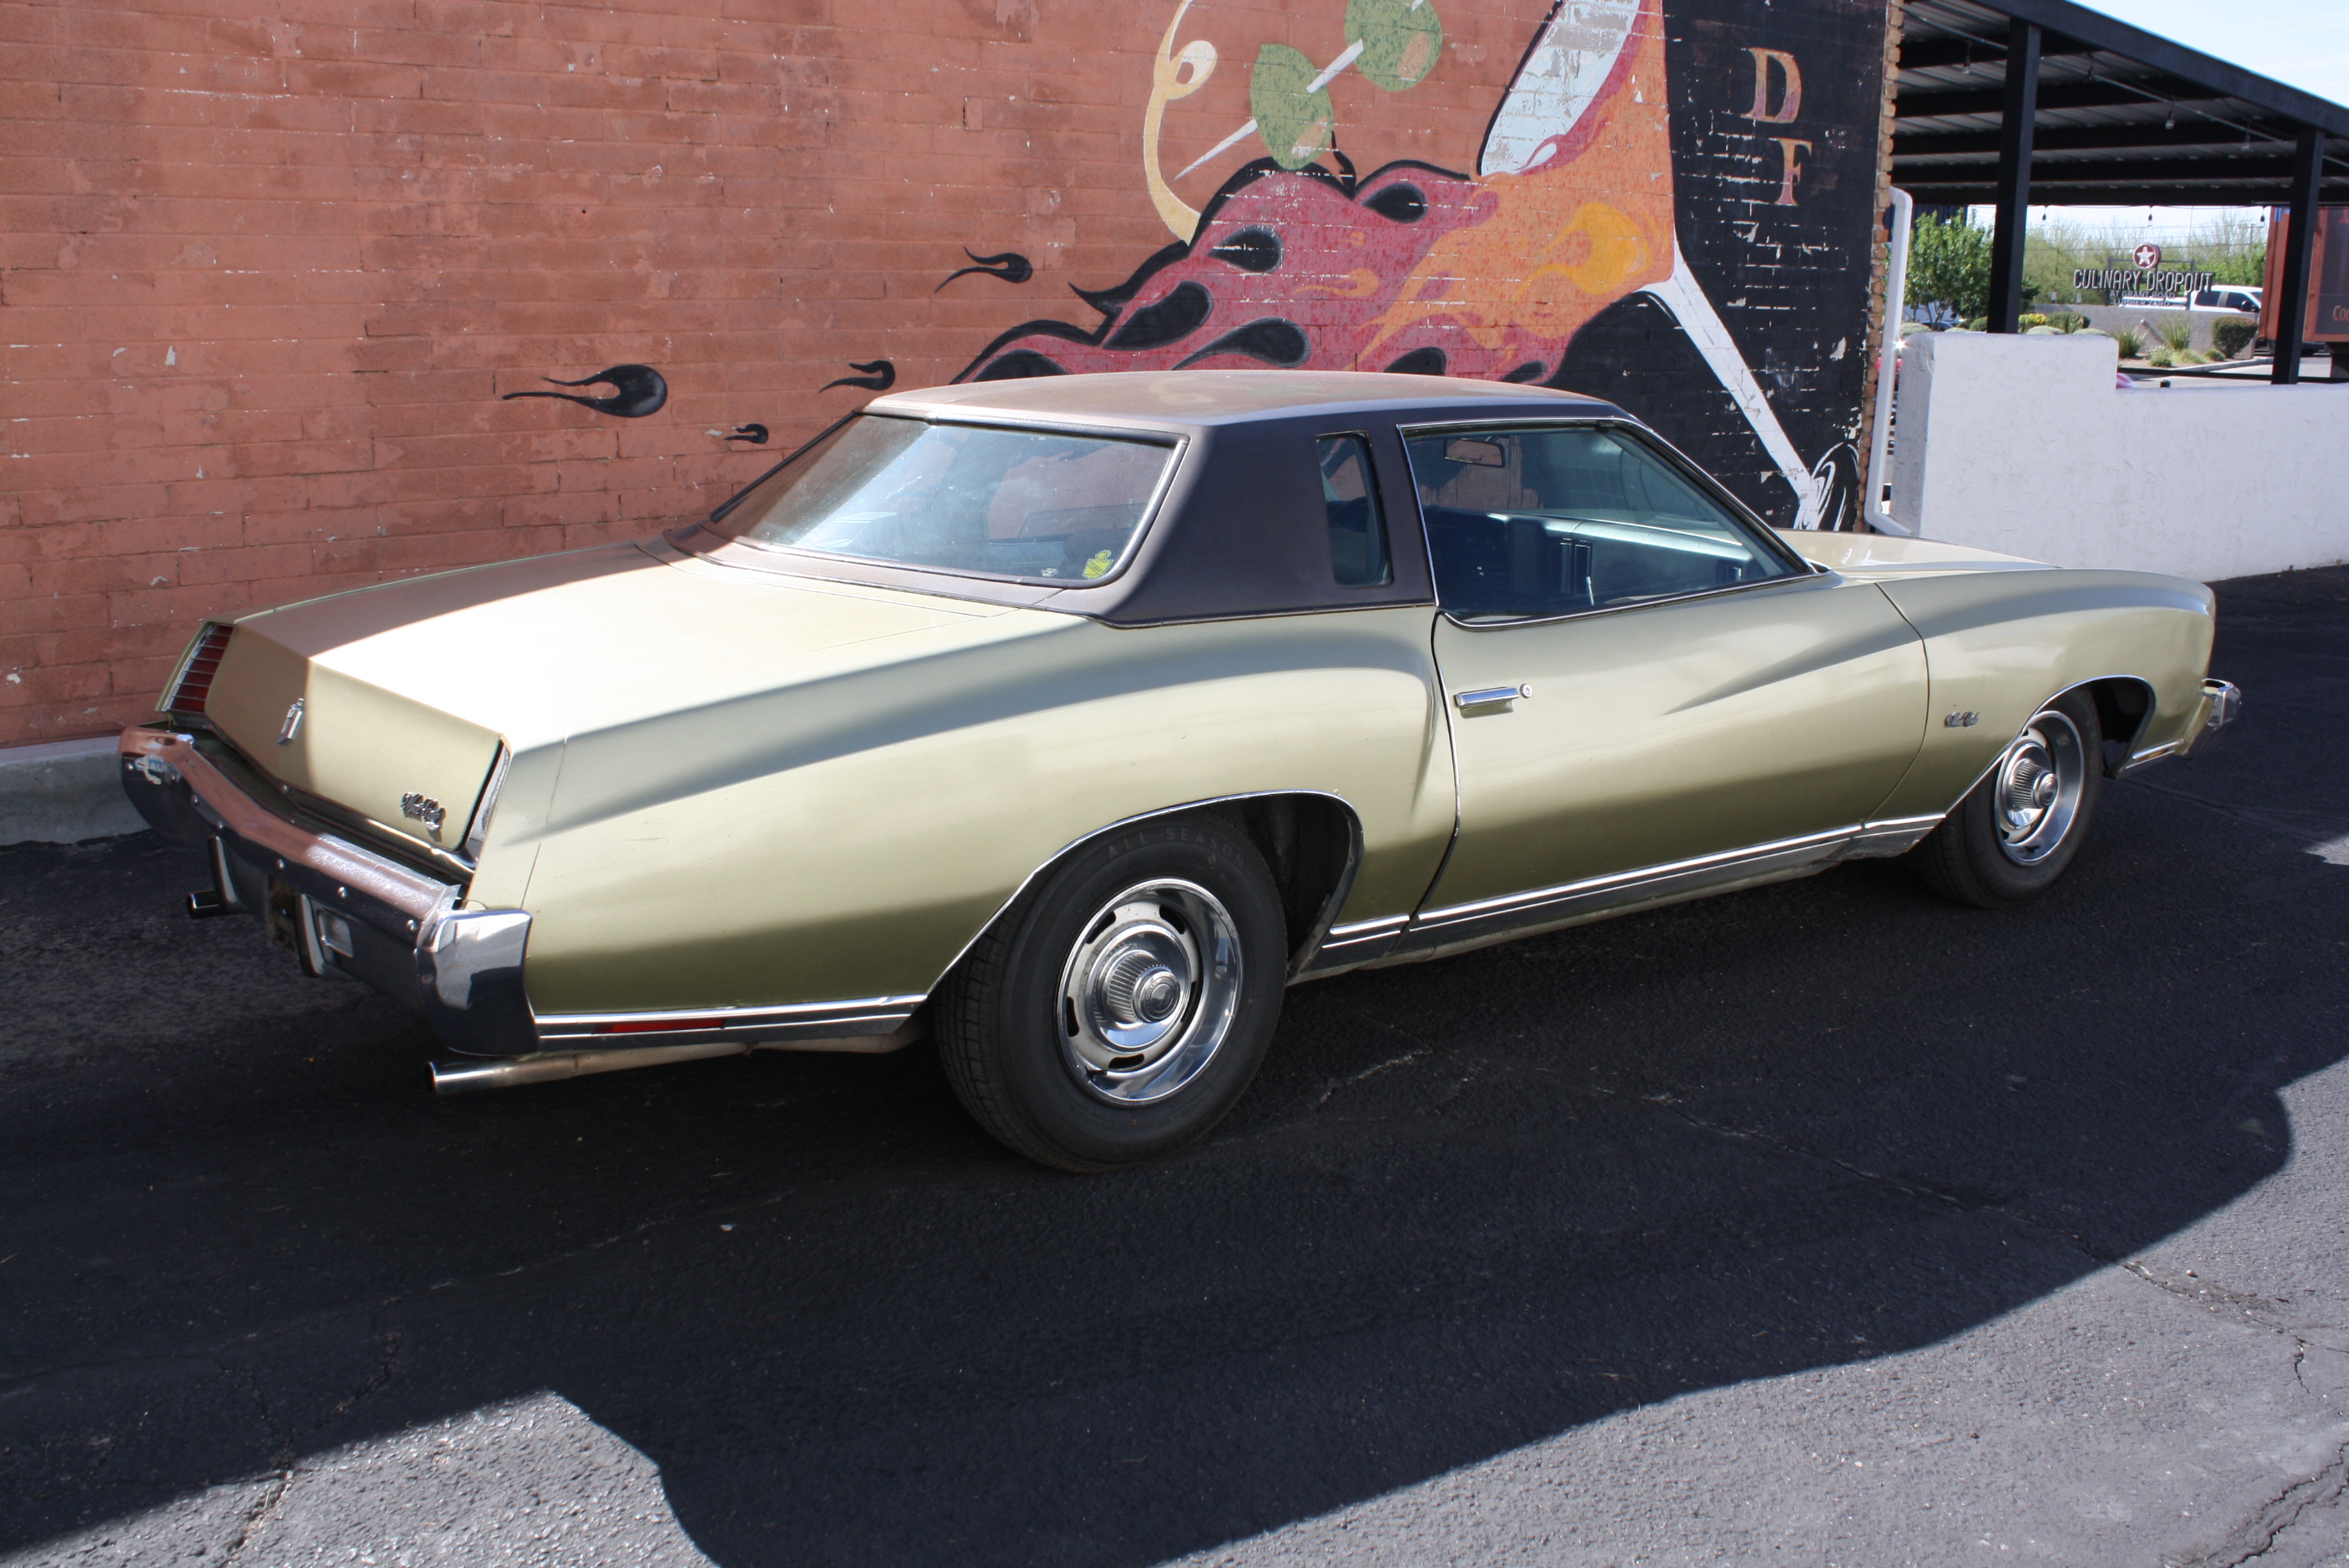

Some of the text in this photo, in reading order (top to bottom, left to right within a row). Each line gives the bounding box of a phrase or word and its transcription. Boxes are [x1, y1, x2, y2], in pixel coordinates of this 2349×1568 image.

[1739, 47, 1803, 123] D
[1773, 137, 1813, 207] F
[2074, 269, 2214, 294] CULINARY DROPOUT
[2121, 290, 2150, 299] GRANT
[2151, 291, 2175, 299] ROAD
[1108, 827, 1245, 869] ALL SEASON
